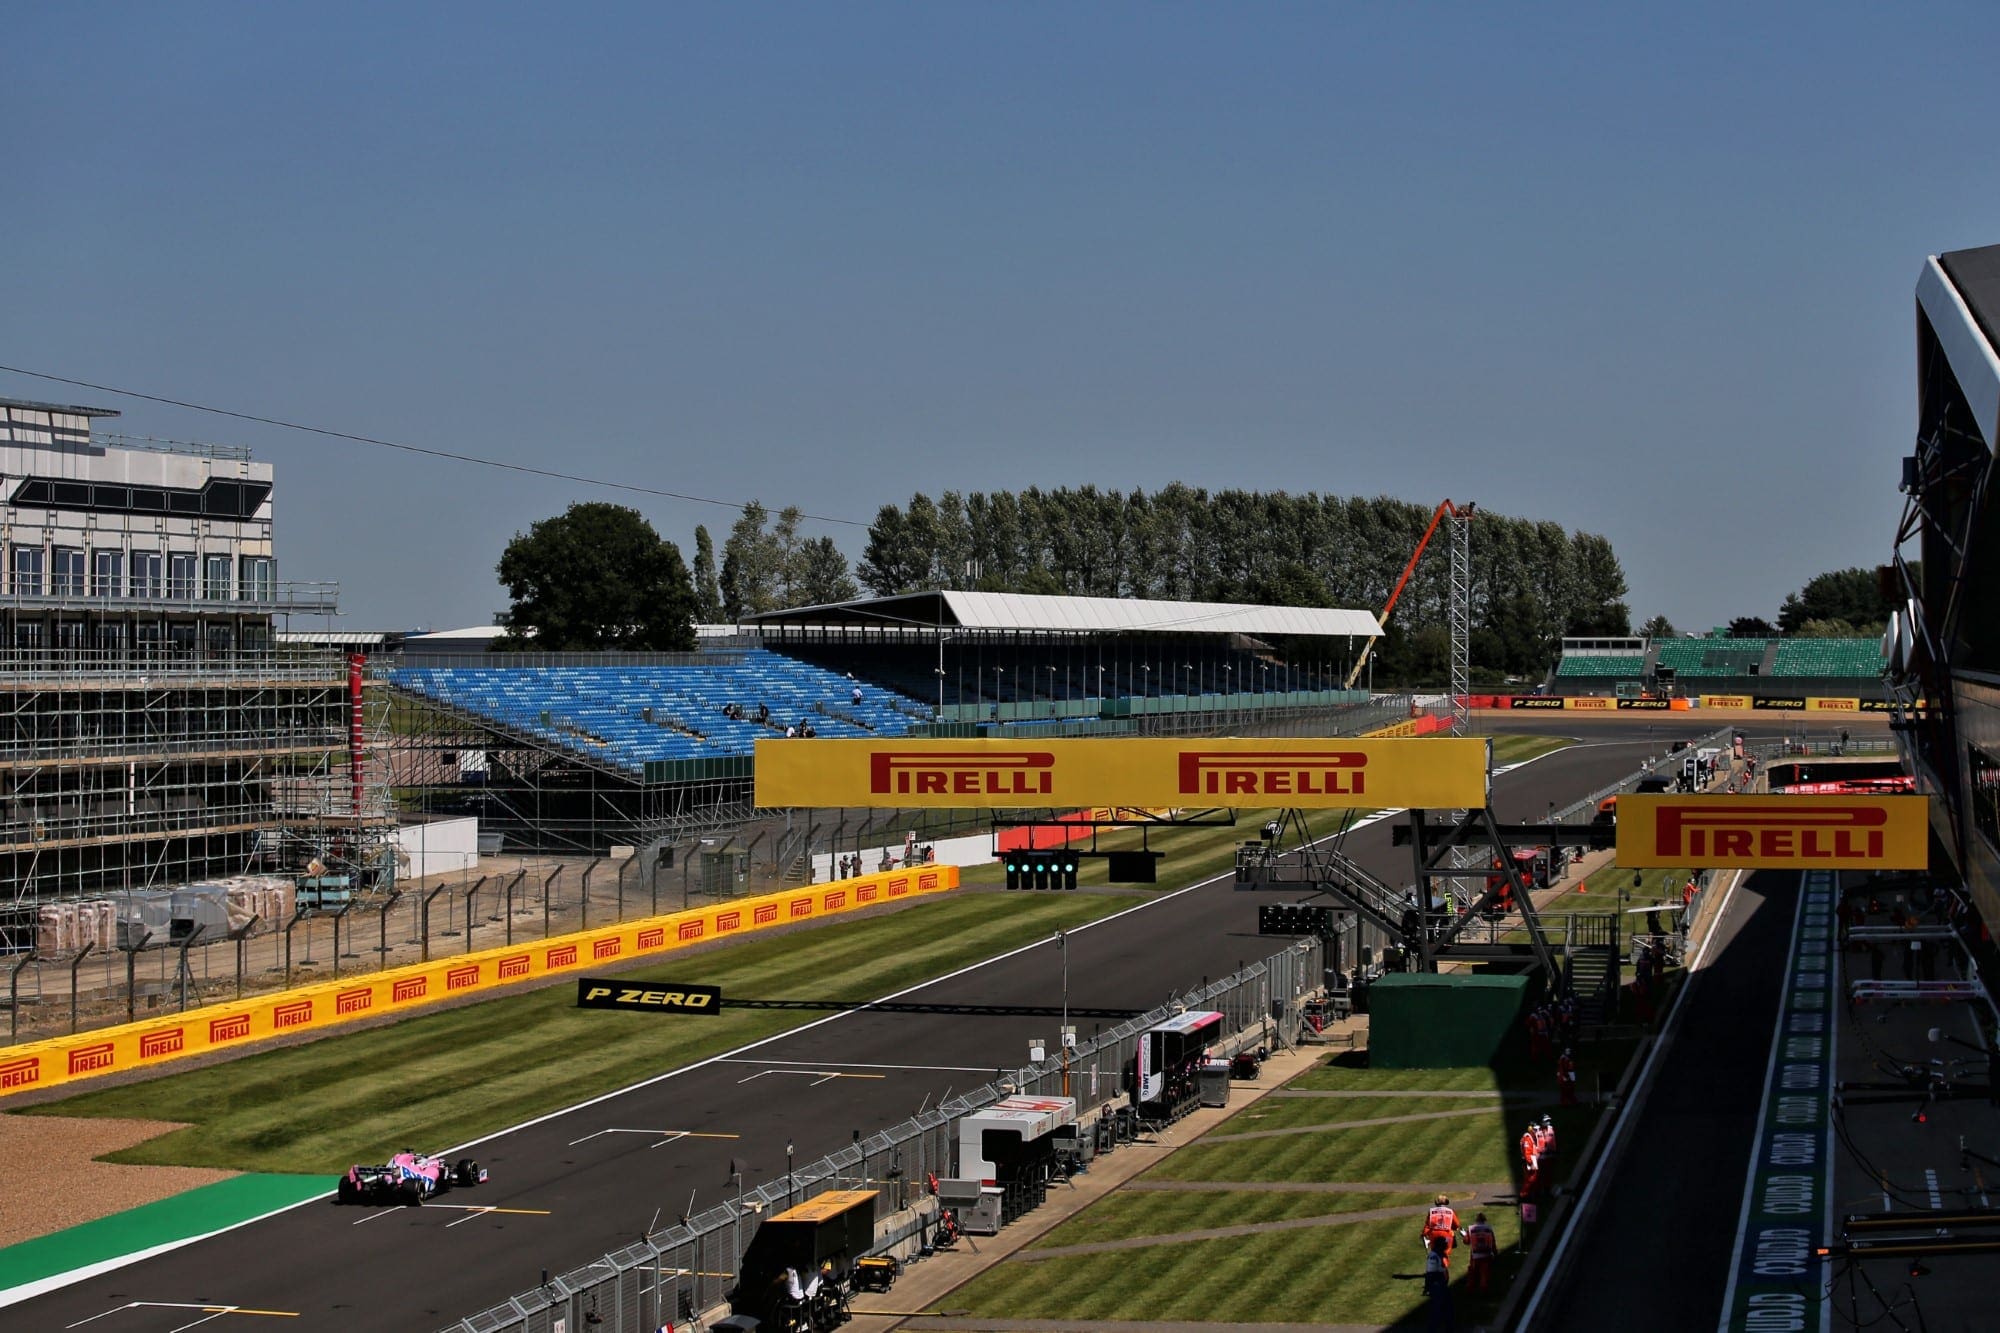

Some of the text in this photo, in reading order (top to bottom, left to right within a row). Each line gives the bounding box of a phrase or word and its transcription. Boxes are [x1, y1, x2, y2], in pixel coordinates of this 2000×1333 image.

[1708, 697, 1744, 707] PIRELLI
[1767, 700, 1804, 708] ZERO
[871, 752, 1368, 794] PIRELLI PIRELLI
[1656, 806, 1887, 858] PIRELLI
[68, 1043, 114, 1075] PIRELLI
[140, 1028, 184, 1058] PIRELLI
[210, 1014, 250, 1043] PIRELLI
[274, 1001, 312, 1028] PIRELLI
[336, 988, 372, 1015] PIRELLI
[393, 976, 427, 1002] PIRELLI
[447, 965, 479, 990] PIRELLI
[499, 955, 530, 979] PIRELLI
[546, 946, 576, 969] PIRELLI
[593, 937, 620, 959] PIRELLI
[637, 928, 663, 949] PIRELLI
[678, 920, 704, 940] PIRELLI
[716, 912, 740, 932] PIRELLI
[753, 904, 777, 924] PIRELLI
[790, 898, 812, 916] PIRELLI
[824, 892, 845, 910] PIRELLI
[856, 885, 877, 901] PIRELLI
[888, 879, 908, 896] PIRELLI
[918, 874, 937, 889] PIRELLI
[586, 987, 712, 1007] P ZERO
[1769, 1133, 1816, 1165] aramco
[1762, 1175, 1815, 1214] aramco
[1752, 1228, 1812, 1275] aramco
[1744, 1292, 1806, 1333] aram
